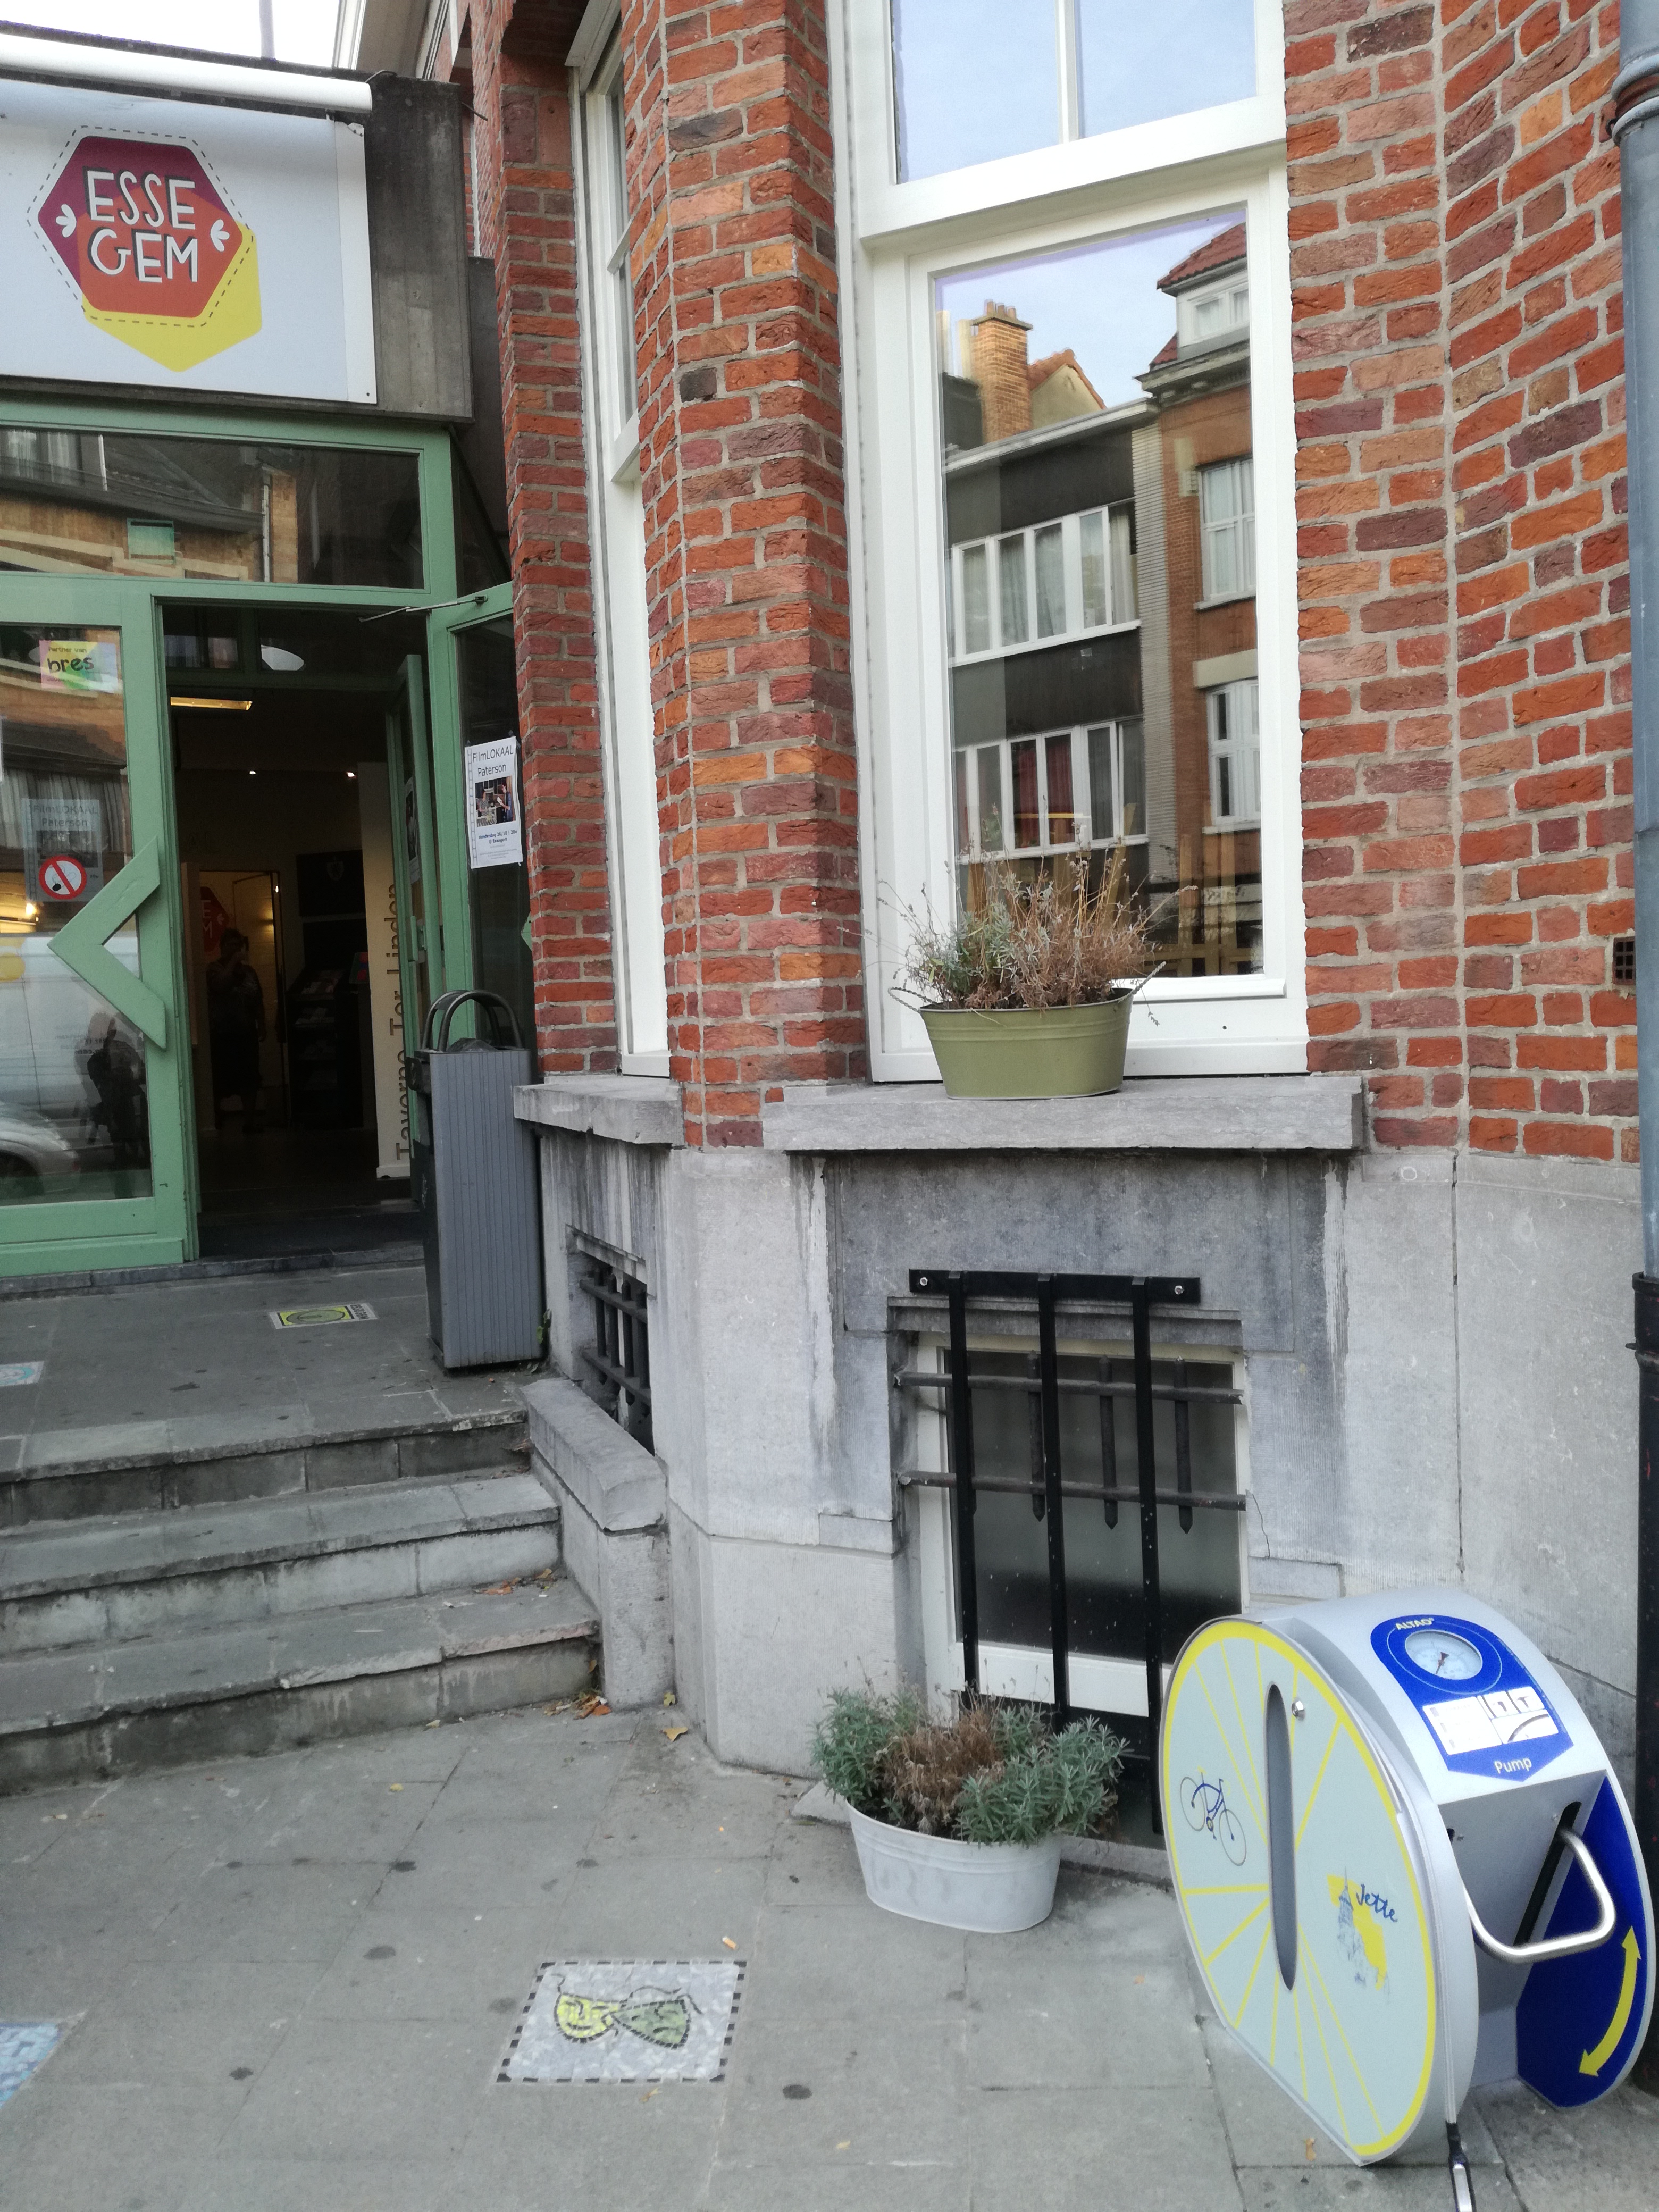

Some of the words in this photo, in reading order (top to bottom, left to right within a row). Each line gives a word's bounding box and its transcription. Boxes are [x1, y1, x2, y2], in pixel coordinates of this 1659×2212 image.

[83, 166, 196, 230] ESSE
[88, 226, 198, 283] GEM
[47, 657, 95, 673] bres
[473, 745, 514, 763] FilmLOKAAL
[477, 764, 506, 777] Paterson
[33, 805, 99, 814] FilmLOKAAL
[1494, 1757, 1532, 1774] Pump
